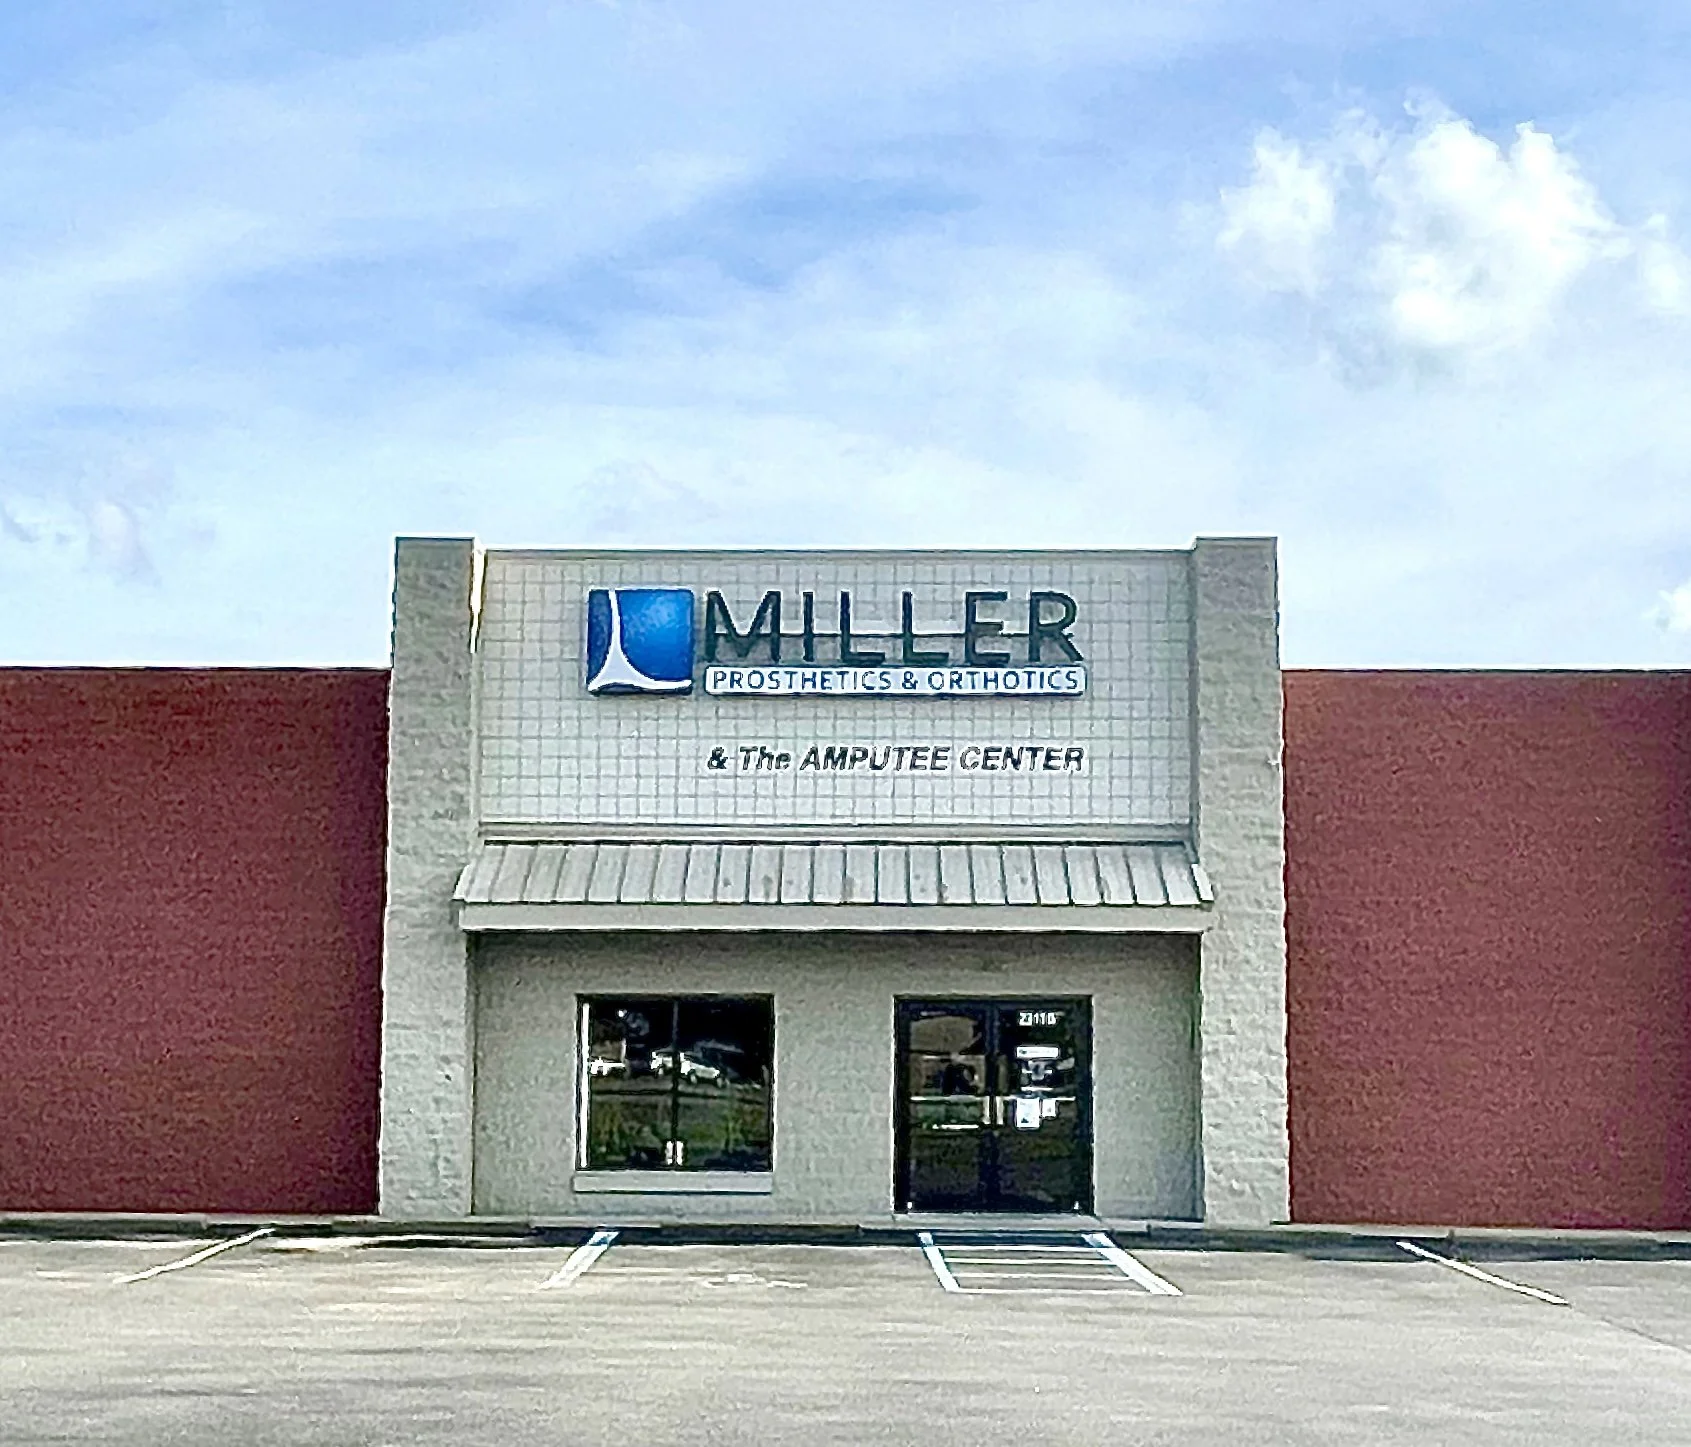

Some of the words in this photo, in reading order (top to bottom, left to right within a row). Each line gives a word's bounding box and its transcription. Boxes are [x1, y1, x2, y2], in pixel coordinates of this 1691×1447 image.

[705, 590, 1085, 665] MILLER
[713, 670, 892, 690] PROSTHETICS
[902, 670, 919, 690] &
[927, 670, 1078, 690] ORTHOTICS
[707, 746, 729, 770] &
[739, 745, 792, 771] The
[799, 745, 951, 771] AMPUTEE
[959, 745, 1085, 771] CENTER
